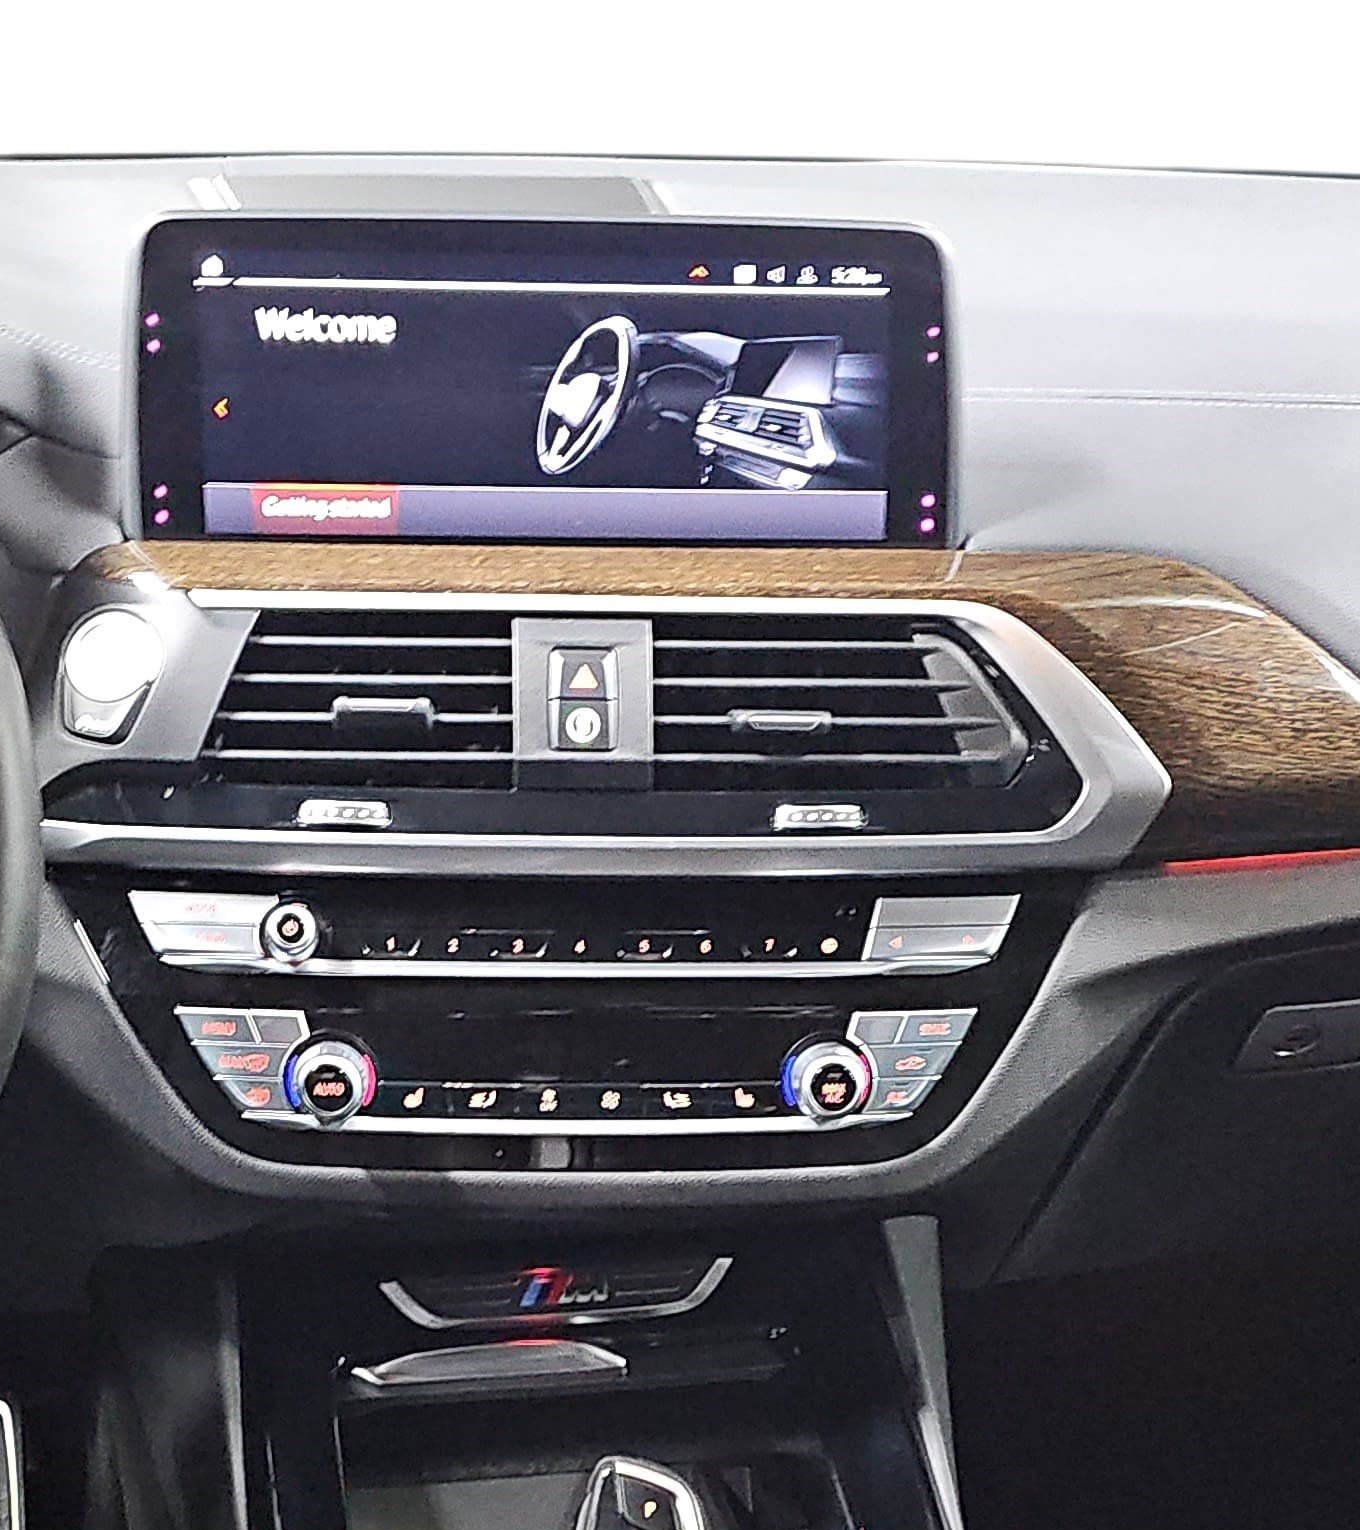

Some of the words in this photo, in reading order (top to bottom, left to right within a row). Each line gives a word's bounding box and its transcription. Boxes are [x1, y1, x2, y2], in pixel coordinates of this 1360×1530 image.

[254, 305, 398, 344] Welcome
[261, 495, 327, 521] Getting
[328, 497, 391, 519] started
[386, 936, 396, 952] 1
[447, 937, 460, 953] 2
[512, 938, 524, 954] 3
[574, 939, 586, 954] 4
[638, 938, 651, 953] 5
[699, 939, 712, 954] 6
[764, 938, 775, 952] 7
[312, 1081, 346, 1097] AUTO
[644, 1500, 658, 1519] P
